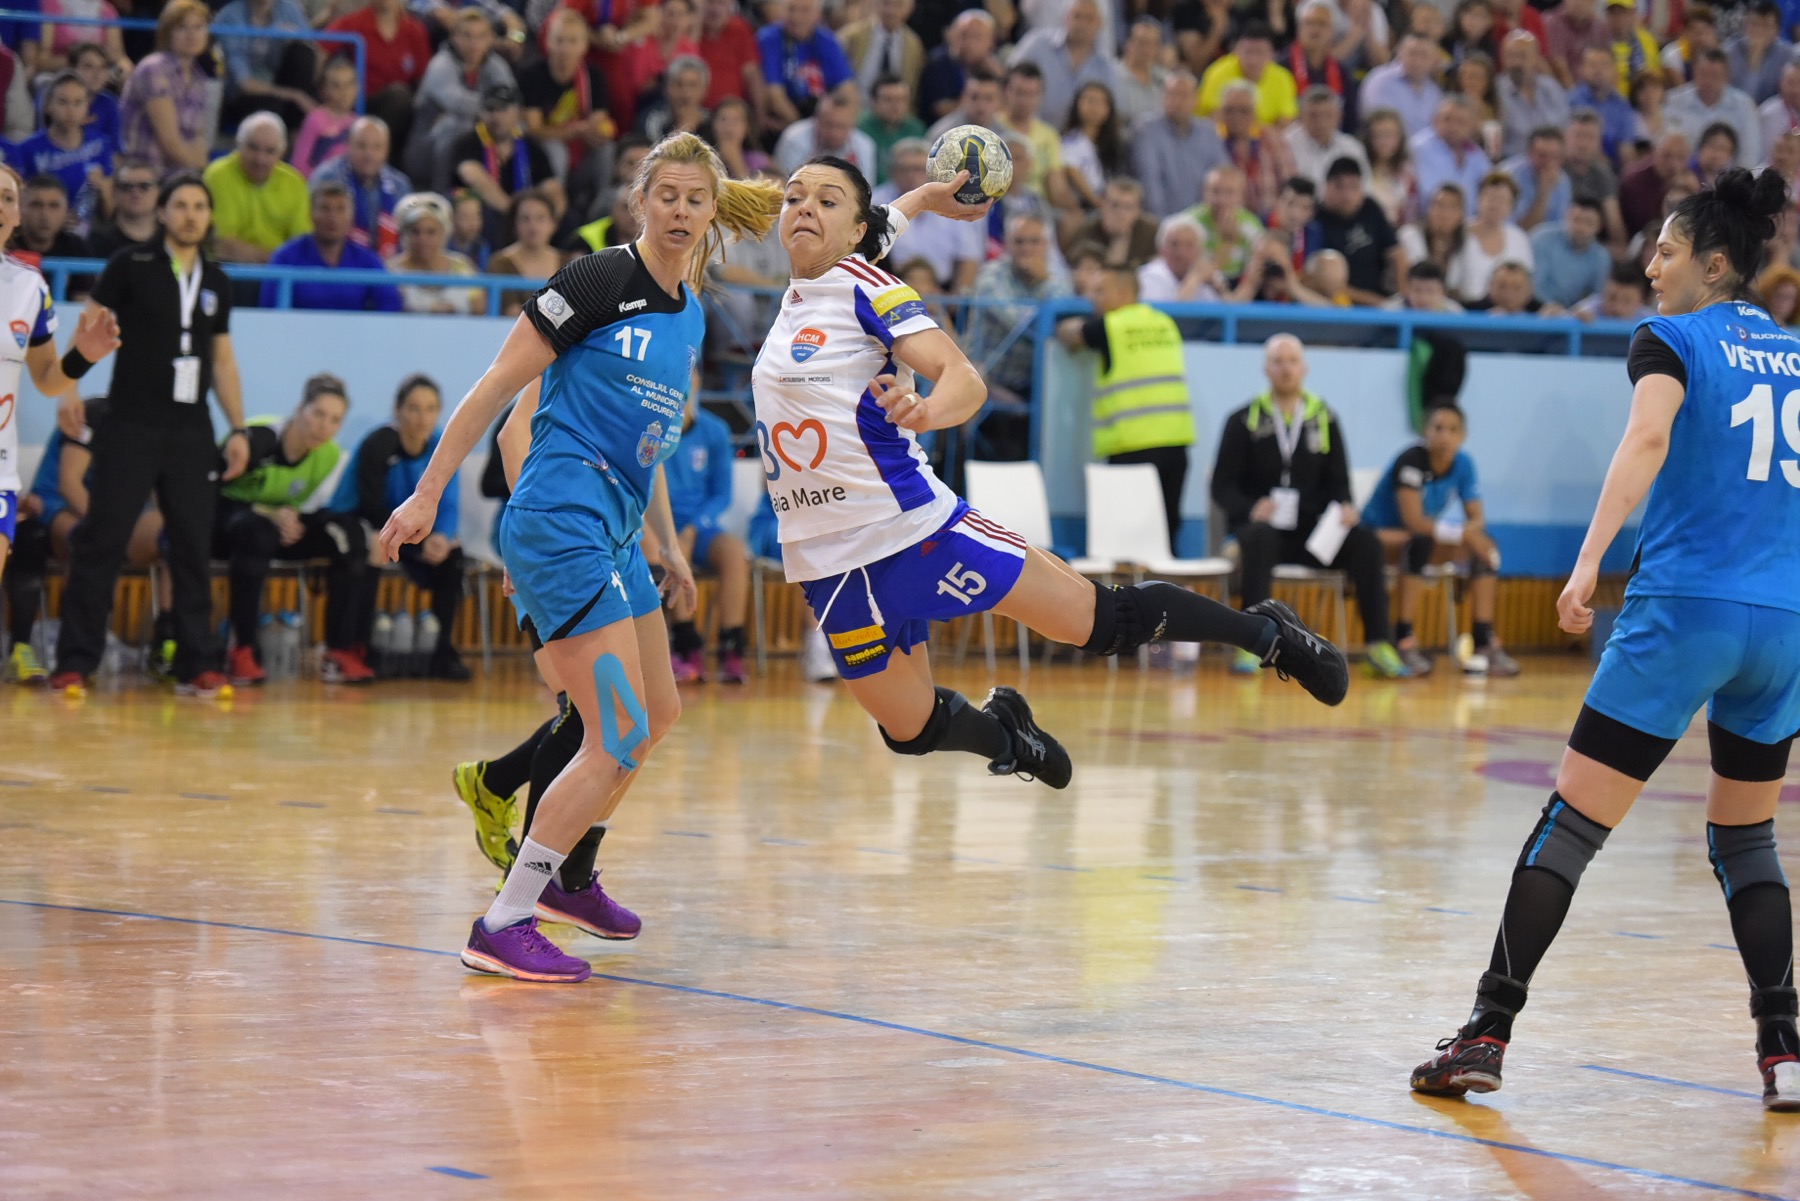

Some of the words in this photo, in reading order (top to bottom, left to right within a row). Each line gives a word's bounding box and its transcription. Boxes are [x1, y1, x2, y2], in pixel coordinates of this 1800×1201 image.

[618, 298, 648, 313] Kempa
[614, 325, 652, 362] 17
[796, 333, 820, 343] HCM
[630, 385, 644, 396] AL
[791, 486, 847, 509] Mare
[936, 561, 987, 606] 15
[844, 644, 885, 662] samdam
